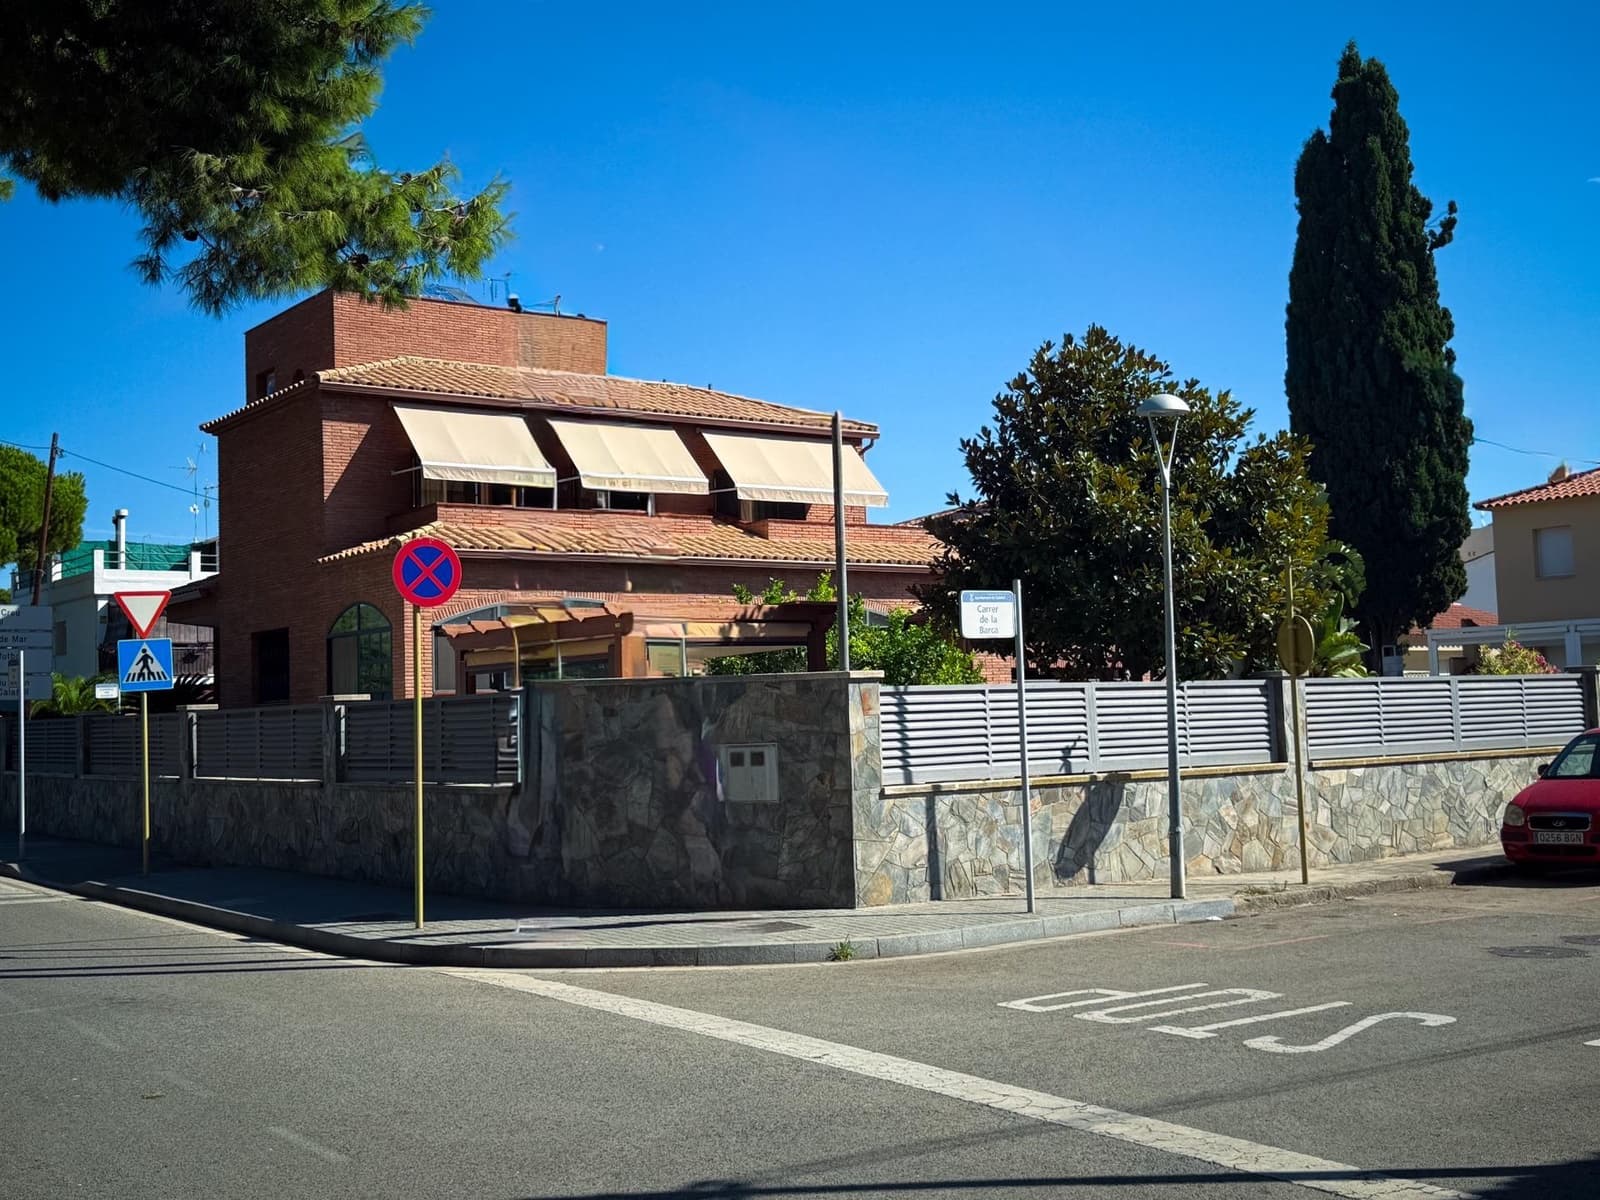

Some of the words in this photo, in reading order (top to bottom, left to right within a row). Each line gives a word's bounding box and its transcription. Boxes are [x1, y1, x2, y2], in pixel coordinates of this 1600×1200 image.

[976, 604, 998, 614] Carrer
[979, 614, 989, 623] de
[990, 614, 998, 623] la
[979, 625, 999, 634] Barca
[12, 635, 27, 643] Mar
